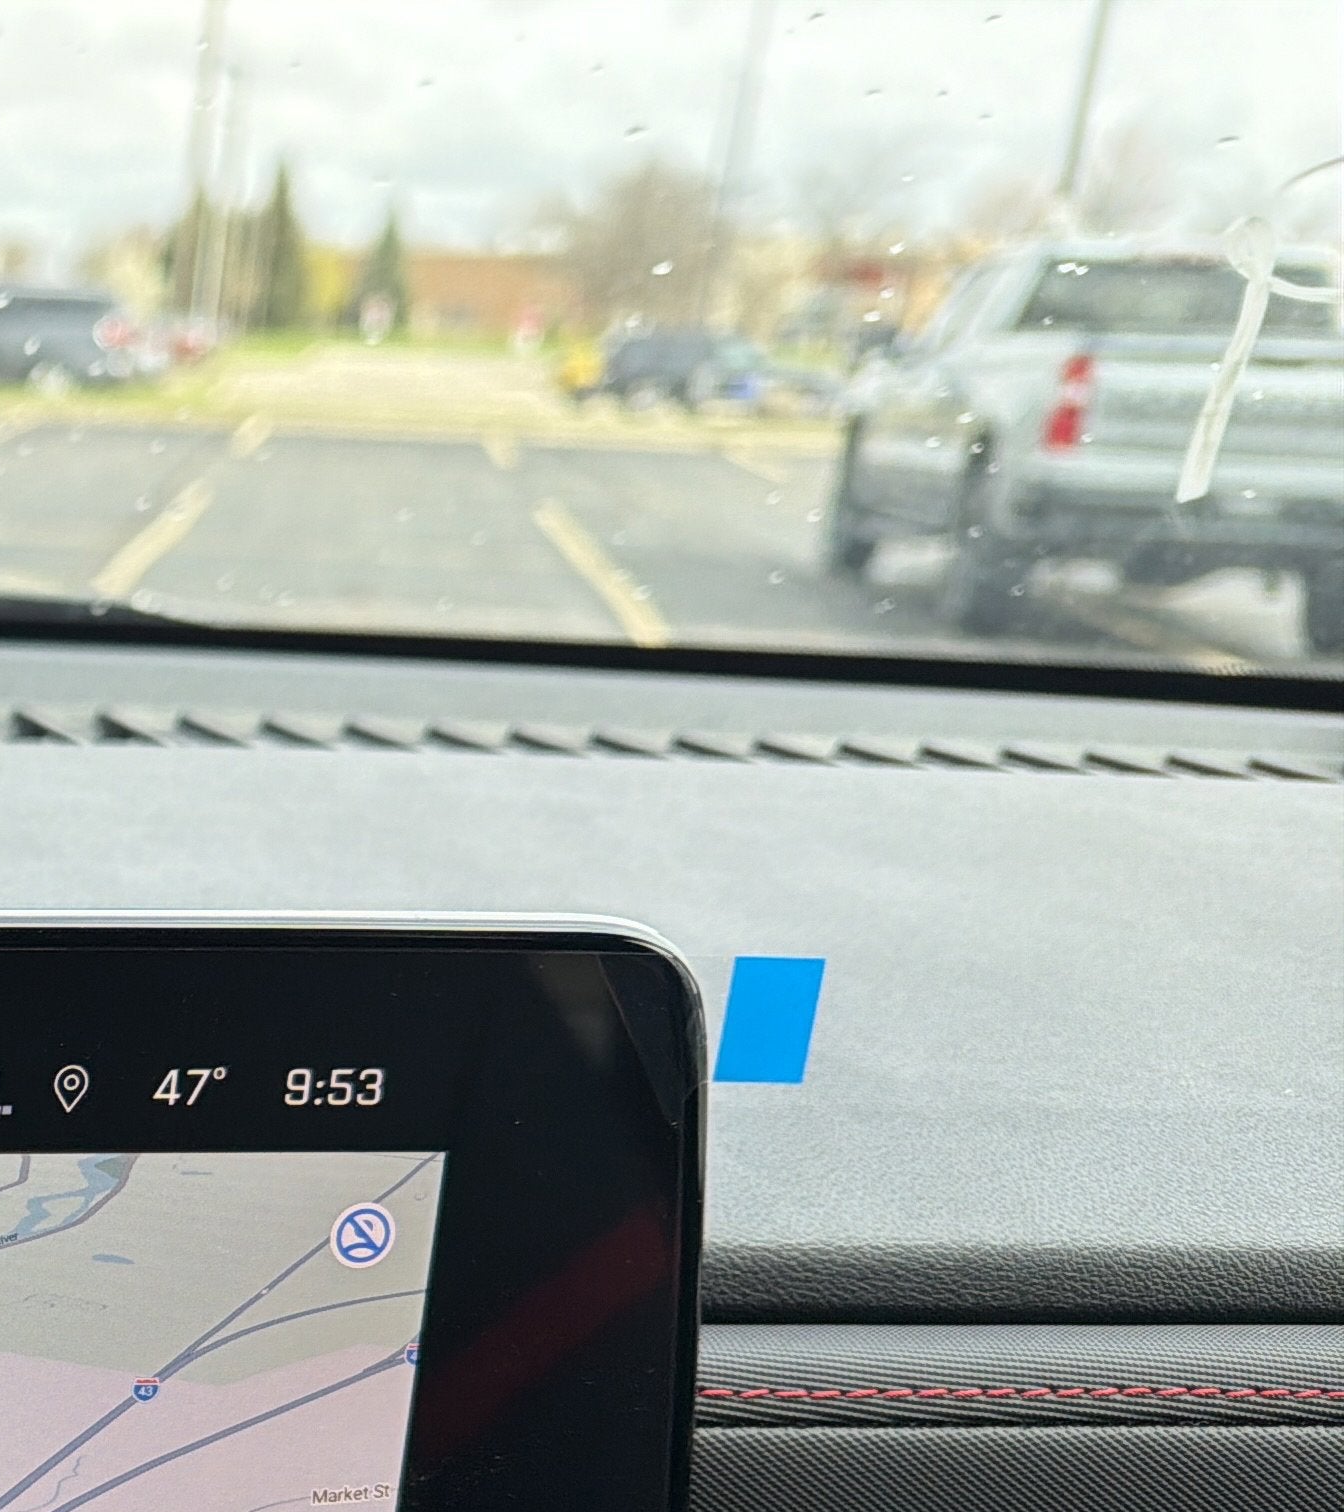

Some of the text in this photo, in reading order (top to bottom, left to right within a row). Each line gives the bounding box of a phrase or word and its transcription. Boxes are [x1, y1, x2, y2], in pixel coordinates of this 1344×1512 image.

[152, 1066, 228, 1106] 47°
[284, 1068, 385, 1107] 9:53
[312, 1484, 391, 1504] Market St
